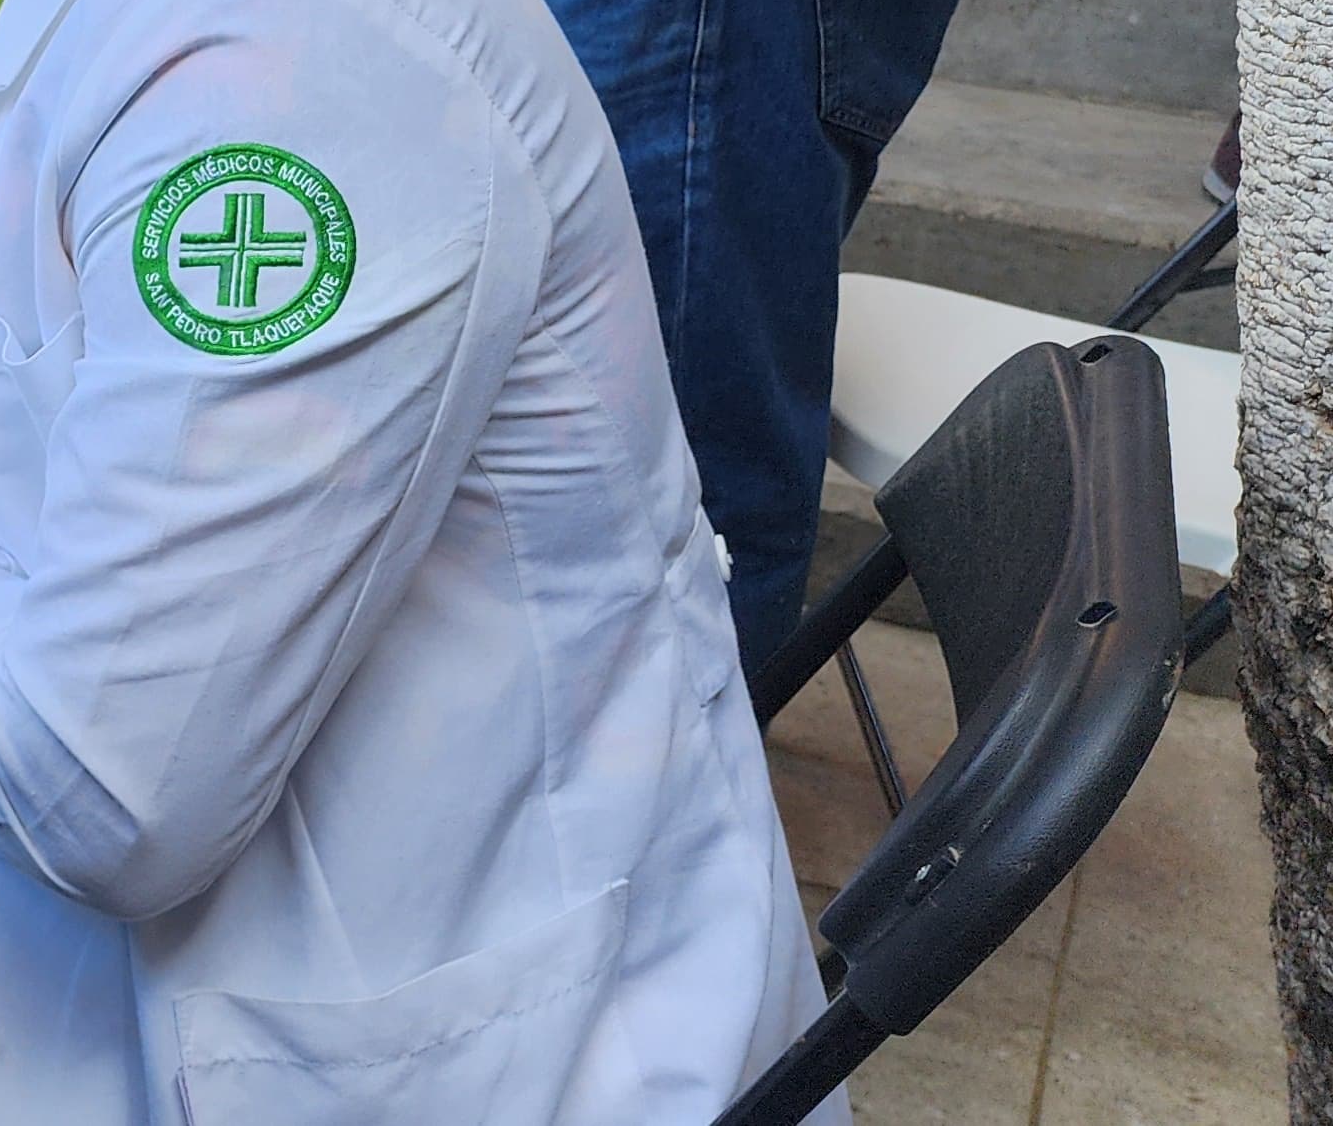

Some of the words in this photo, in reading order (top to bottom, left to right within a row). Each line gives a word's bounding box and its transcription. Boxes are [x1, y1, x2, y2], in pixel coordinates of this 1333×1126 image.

[141, 176, 193, 261] SERVICIOS
[193, 155, 278, 188] MÉDICOS
[277, 160, 347, 265] MUNICIPALES
[145, 272, 176, 308] SAN
[165, 305, 222, 345] PEDRO
[228, 271, 341, 348] TLAQUEPAQUE
